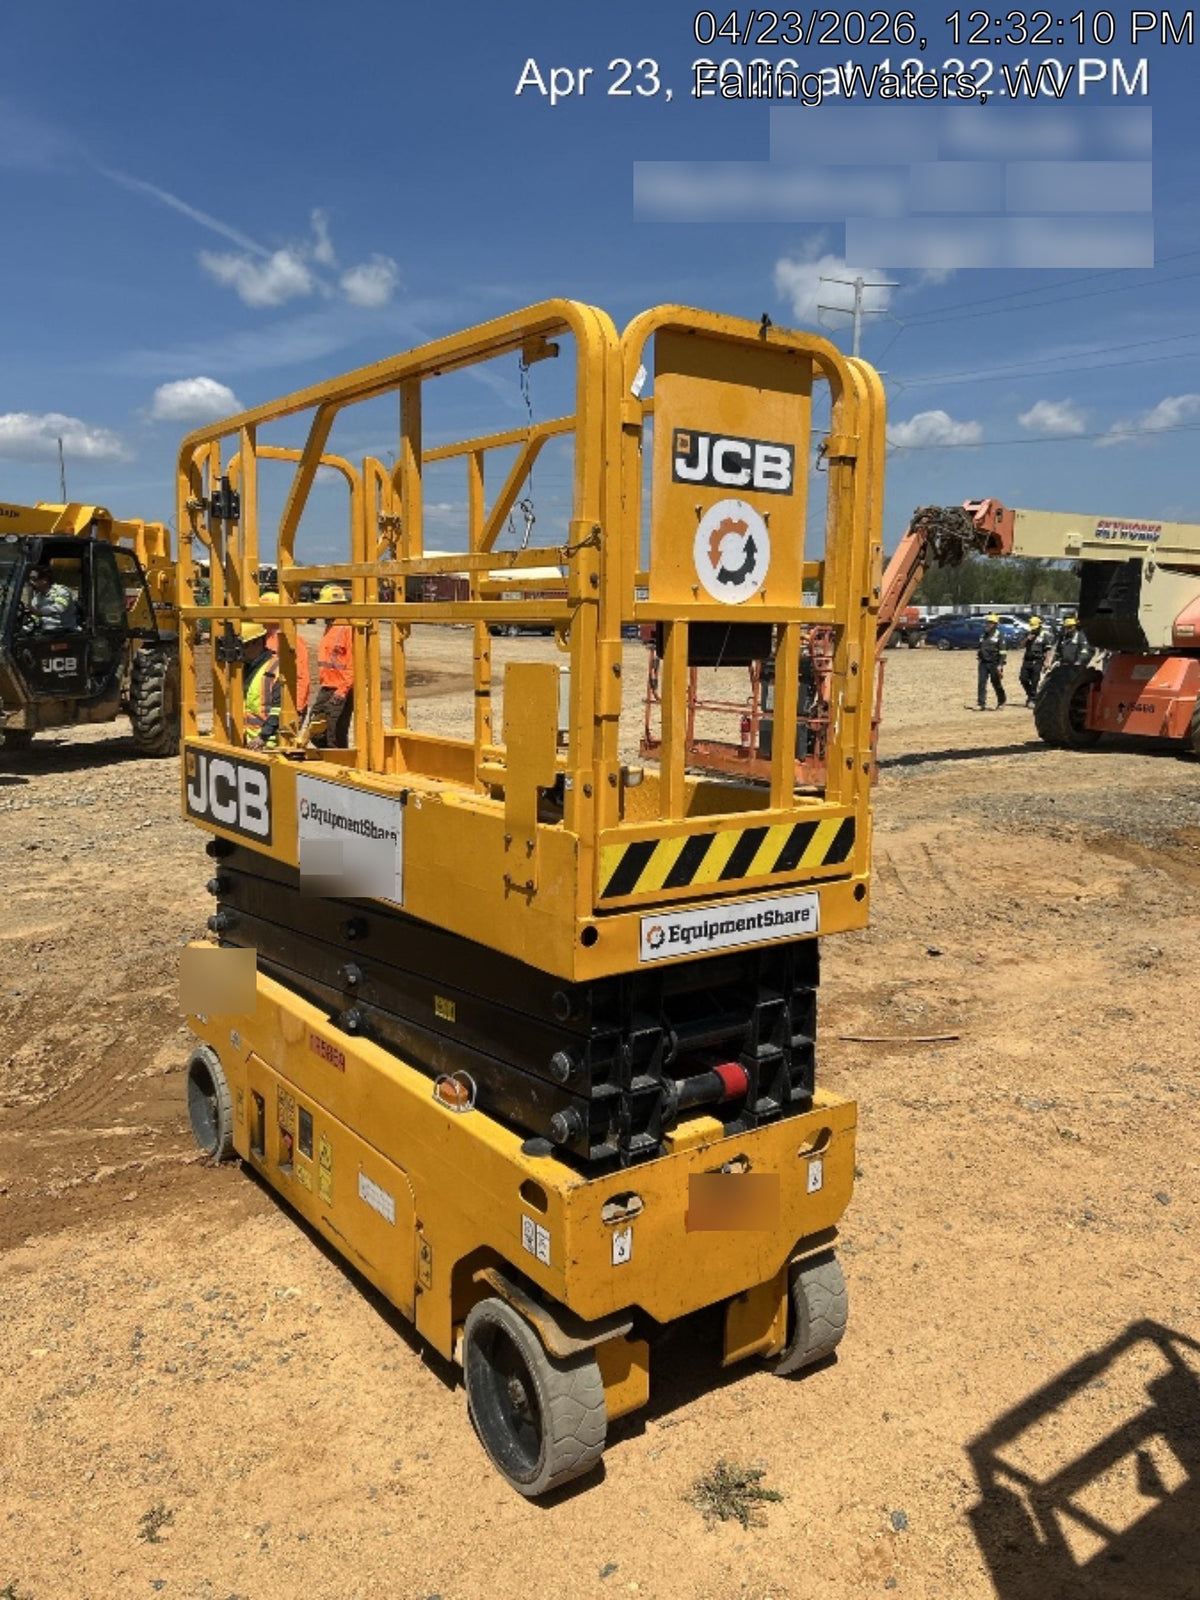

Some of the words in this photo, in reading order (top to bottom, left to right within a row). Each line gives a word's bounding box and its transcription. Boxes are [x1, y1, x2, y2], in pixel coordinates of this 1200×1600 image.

[675, 436, 791, 489] JCB
[42, 657, 77, 672] JCB
[187, 754, 270, 837] JCB
[668, 908, 810, 944] EquipmentShare
